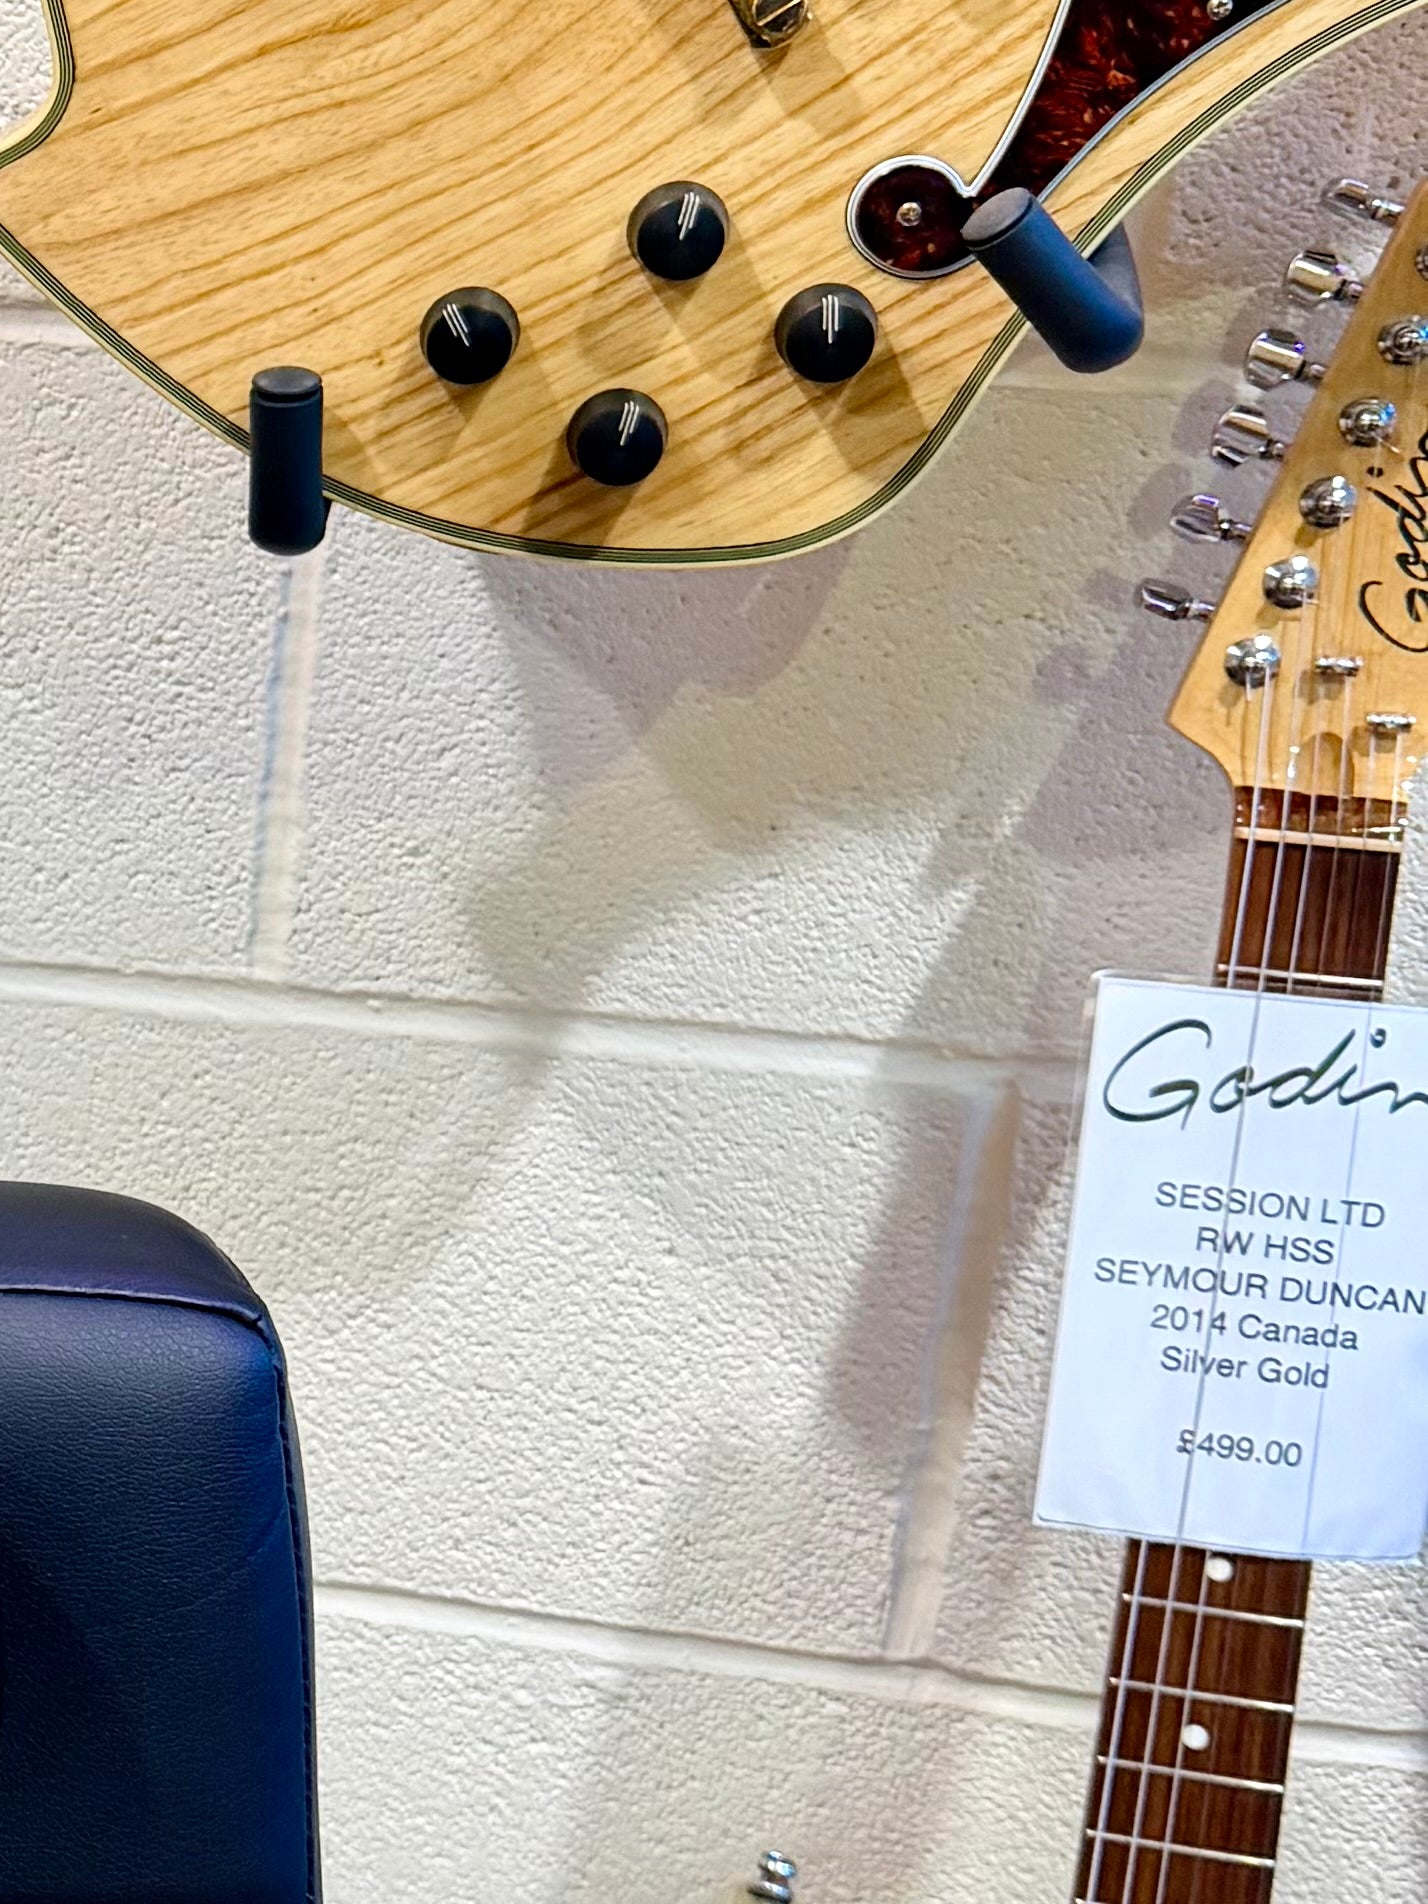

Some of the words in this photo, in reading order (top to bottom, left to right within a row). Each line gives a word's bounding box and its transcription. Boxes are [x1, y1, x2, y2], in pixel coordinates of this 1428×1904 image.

[1103, 1018, 1428, 1131] Godin
[1154, 1181, 1310, 1223] SESSION
[1320, 1199, 1386, 1229] LTD
[1195, 1226, 1254, 1256] RW
[1263, 1235, 1335, 1266] HSS
[1094, 1257, 1268, 1299] SEYMOUR
[1279, 1276, 1427, 1316] DUNCAN
[1149, 1305, 1229, 1336] 2014
[1238, 1315, 1360, 1351] Canada
[1161, 1345, 1248, 1379] Silver
[1257, 1357, 1330, 1389] Gold
[1176, 1428, 1304, 1468] £499.00
